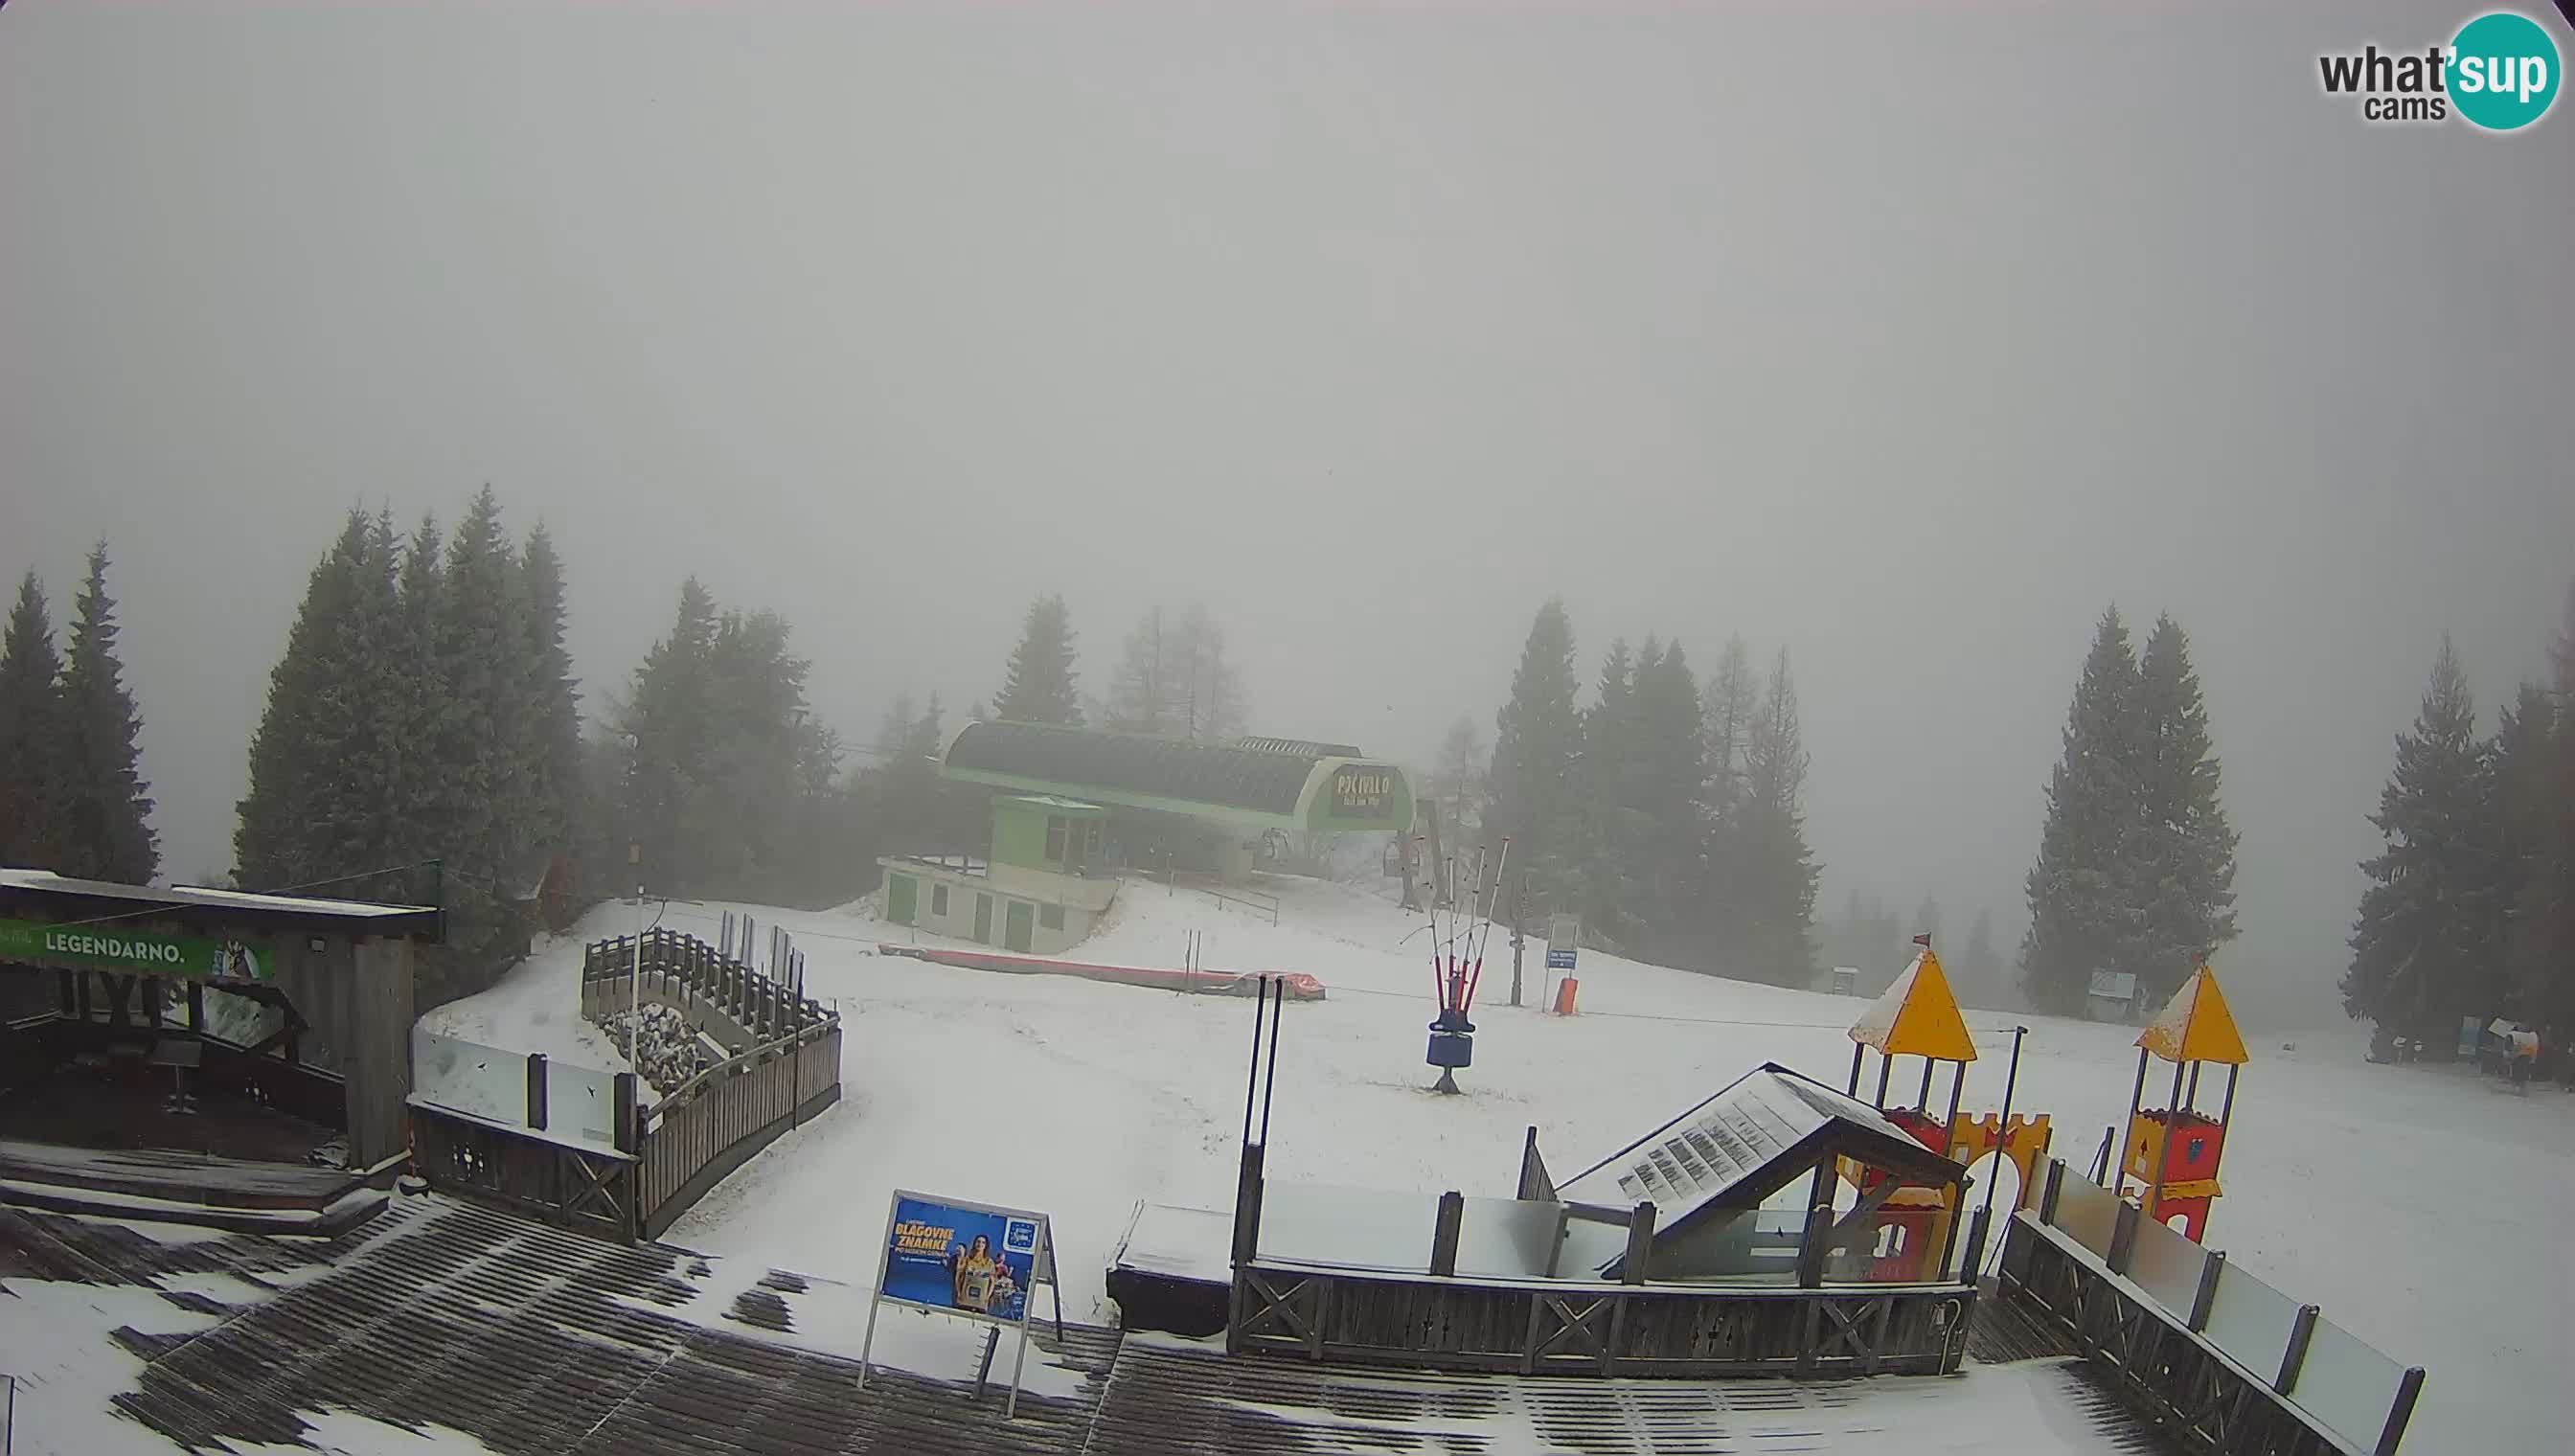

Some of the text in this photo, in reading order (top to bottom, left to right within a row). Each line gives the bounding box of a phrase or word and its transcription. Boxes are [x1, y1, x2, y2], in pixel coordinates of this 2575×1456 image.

[46, 932, 185, 964] LEGENDARNO.
[895, 1222, 955, 1240] BLAGOVNE
[897, 1236, 948, 1251] ZNAMKE
